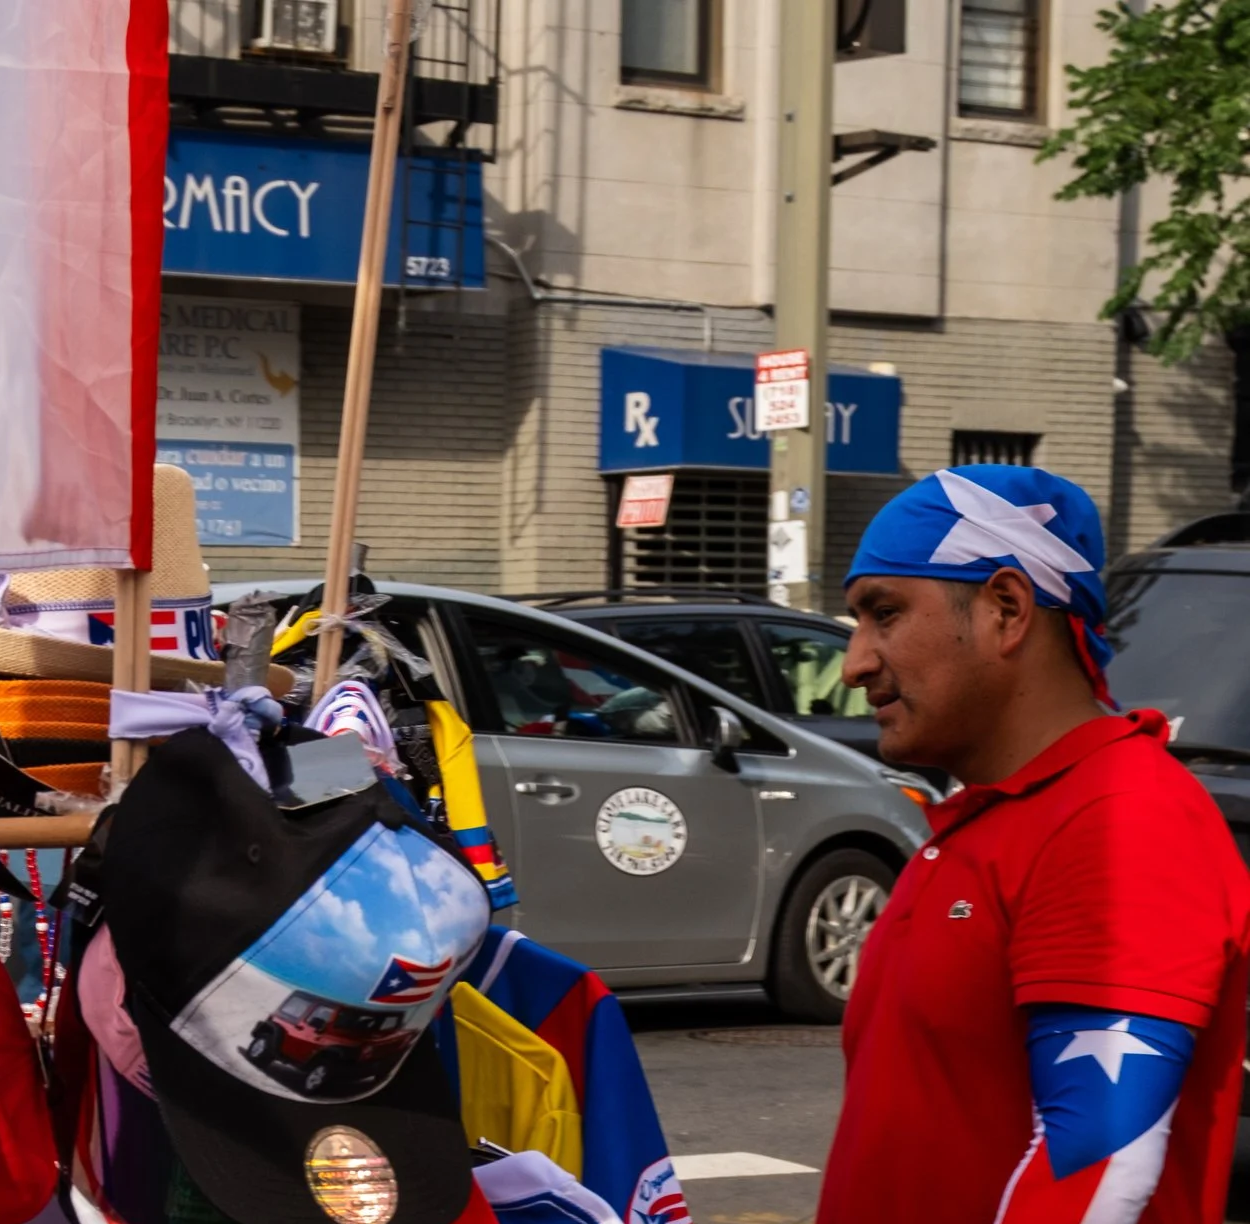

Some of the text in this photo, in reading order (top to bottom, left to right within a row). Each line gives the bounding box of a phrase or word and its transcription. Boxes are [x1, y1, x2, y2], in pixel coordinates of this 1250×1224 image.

[406, 257, 450, 277] 5723
[176, 304, 293, 333] MEDICAL
[180, 386, 209, 402] Juan
